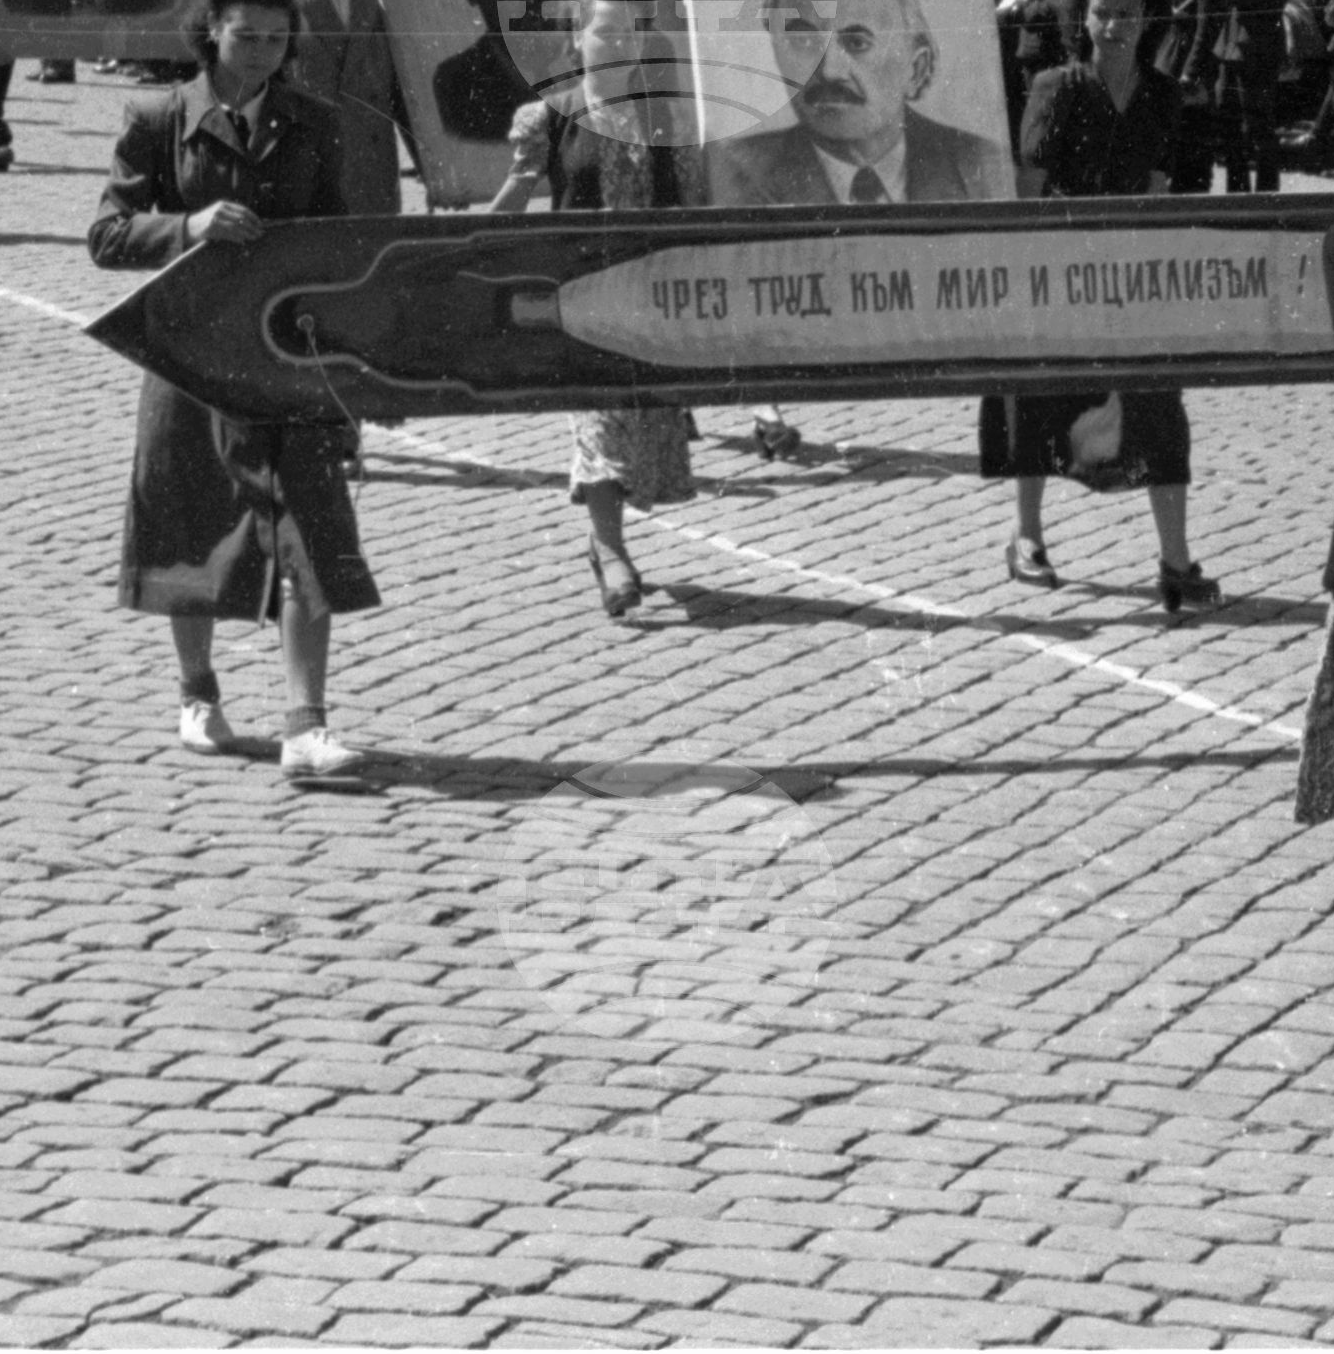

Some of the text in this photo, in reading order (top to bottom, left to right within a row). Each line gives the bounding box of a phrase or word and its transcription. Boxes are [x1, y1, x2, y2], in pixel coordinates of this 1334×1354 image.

[651, 277, 729, 321] ЧРЕЗ
[747, 272, 832, 319] ТРУД
[850, 268, 915, 314] КЪМ
[936, 265, 1009, 312] МИР
[1029, 262, 1050, 307] И
[1066, 256, 1268, 309] СОЦИАЛИЗЪМ
